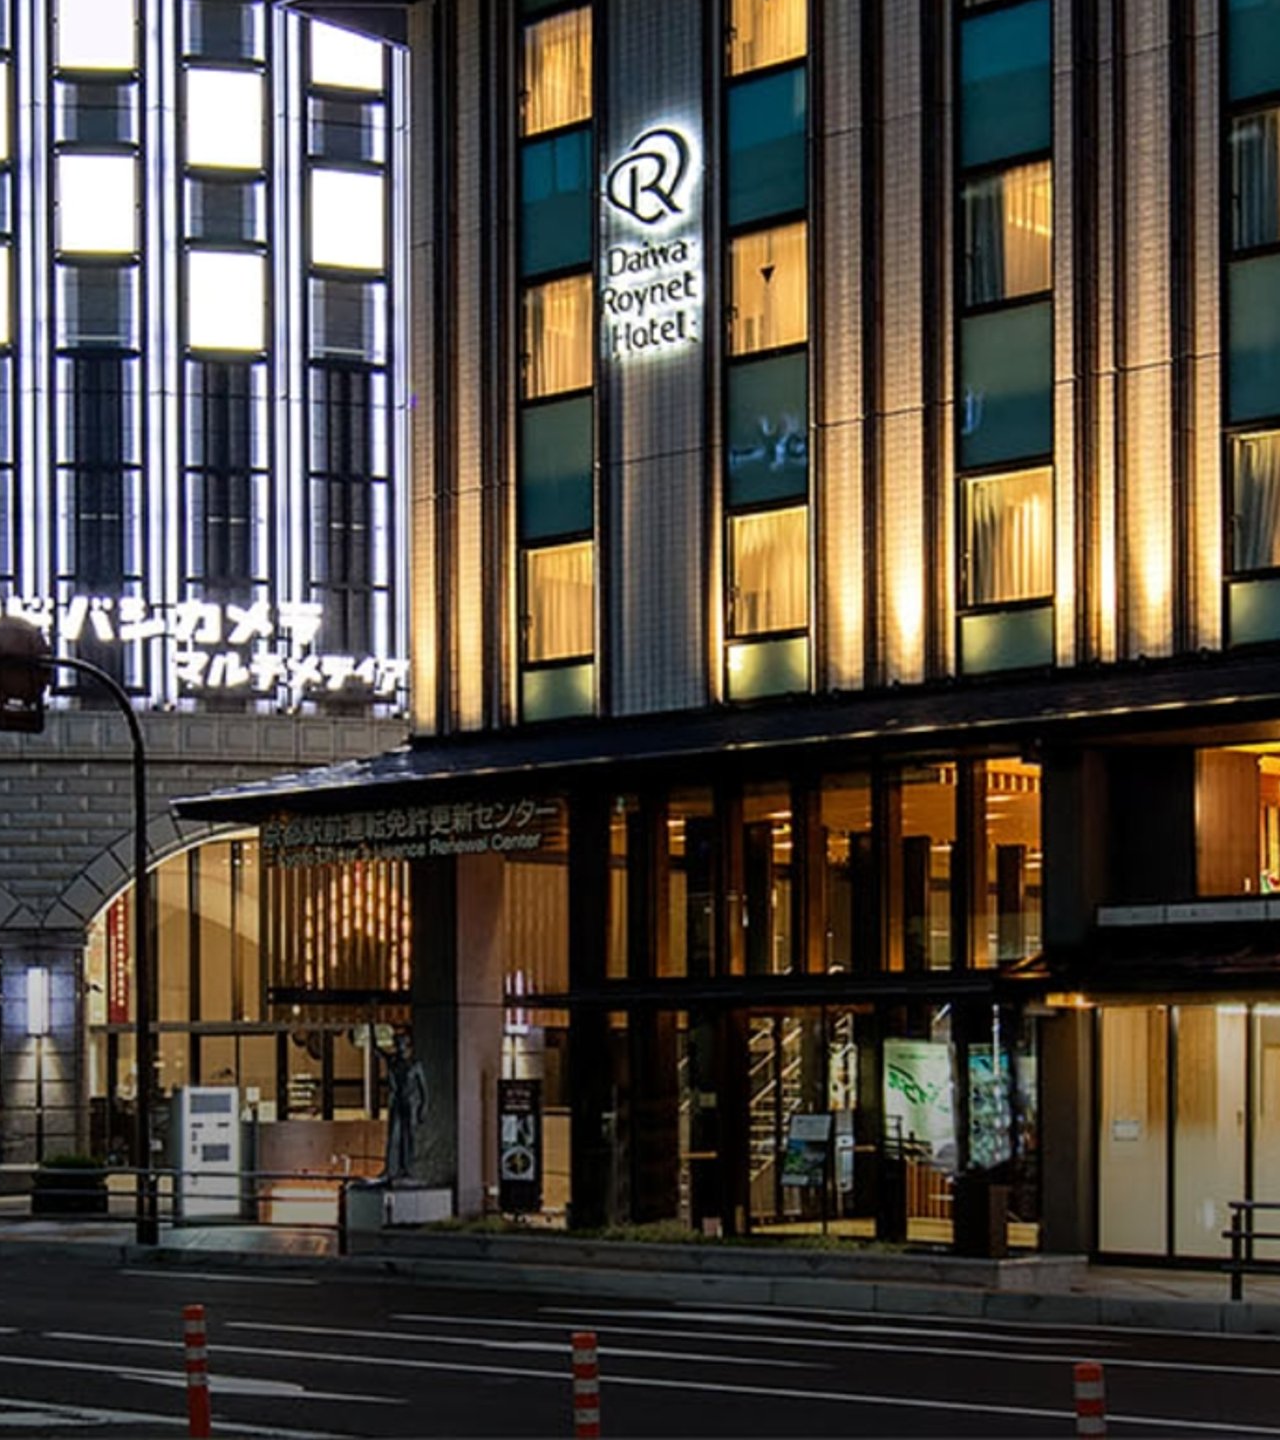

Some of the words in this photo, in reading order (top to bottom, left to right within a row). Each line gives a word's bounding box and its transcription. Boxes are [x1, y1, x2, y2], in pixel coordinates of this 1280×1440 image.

[607, 240, 688, 278] Daiwa
[604, 271, 697, 317] Roynet
[611, 310, 687, 354] Hotel
[173, 650, 410, 694] マルチメディア
